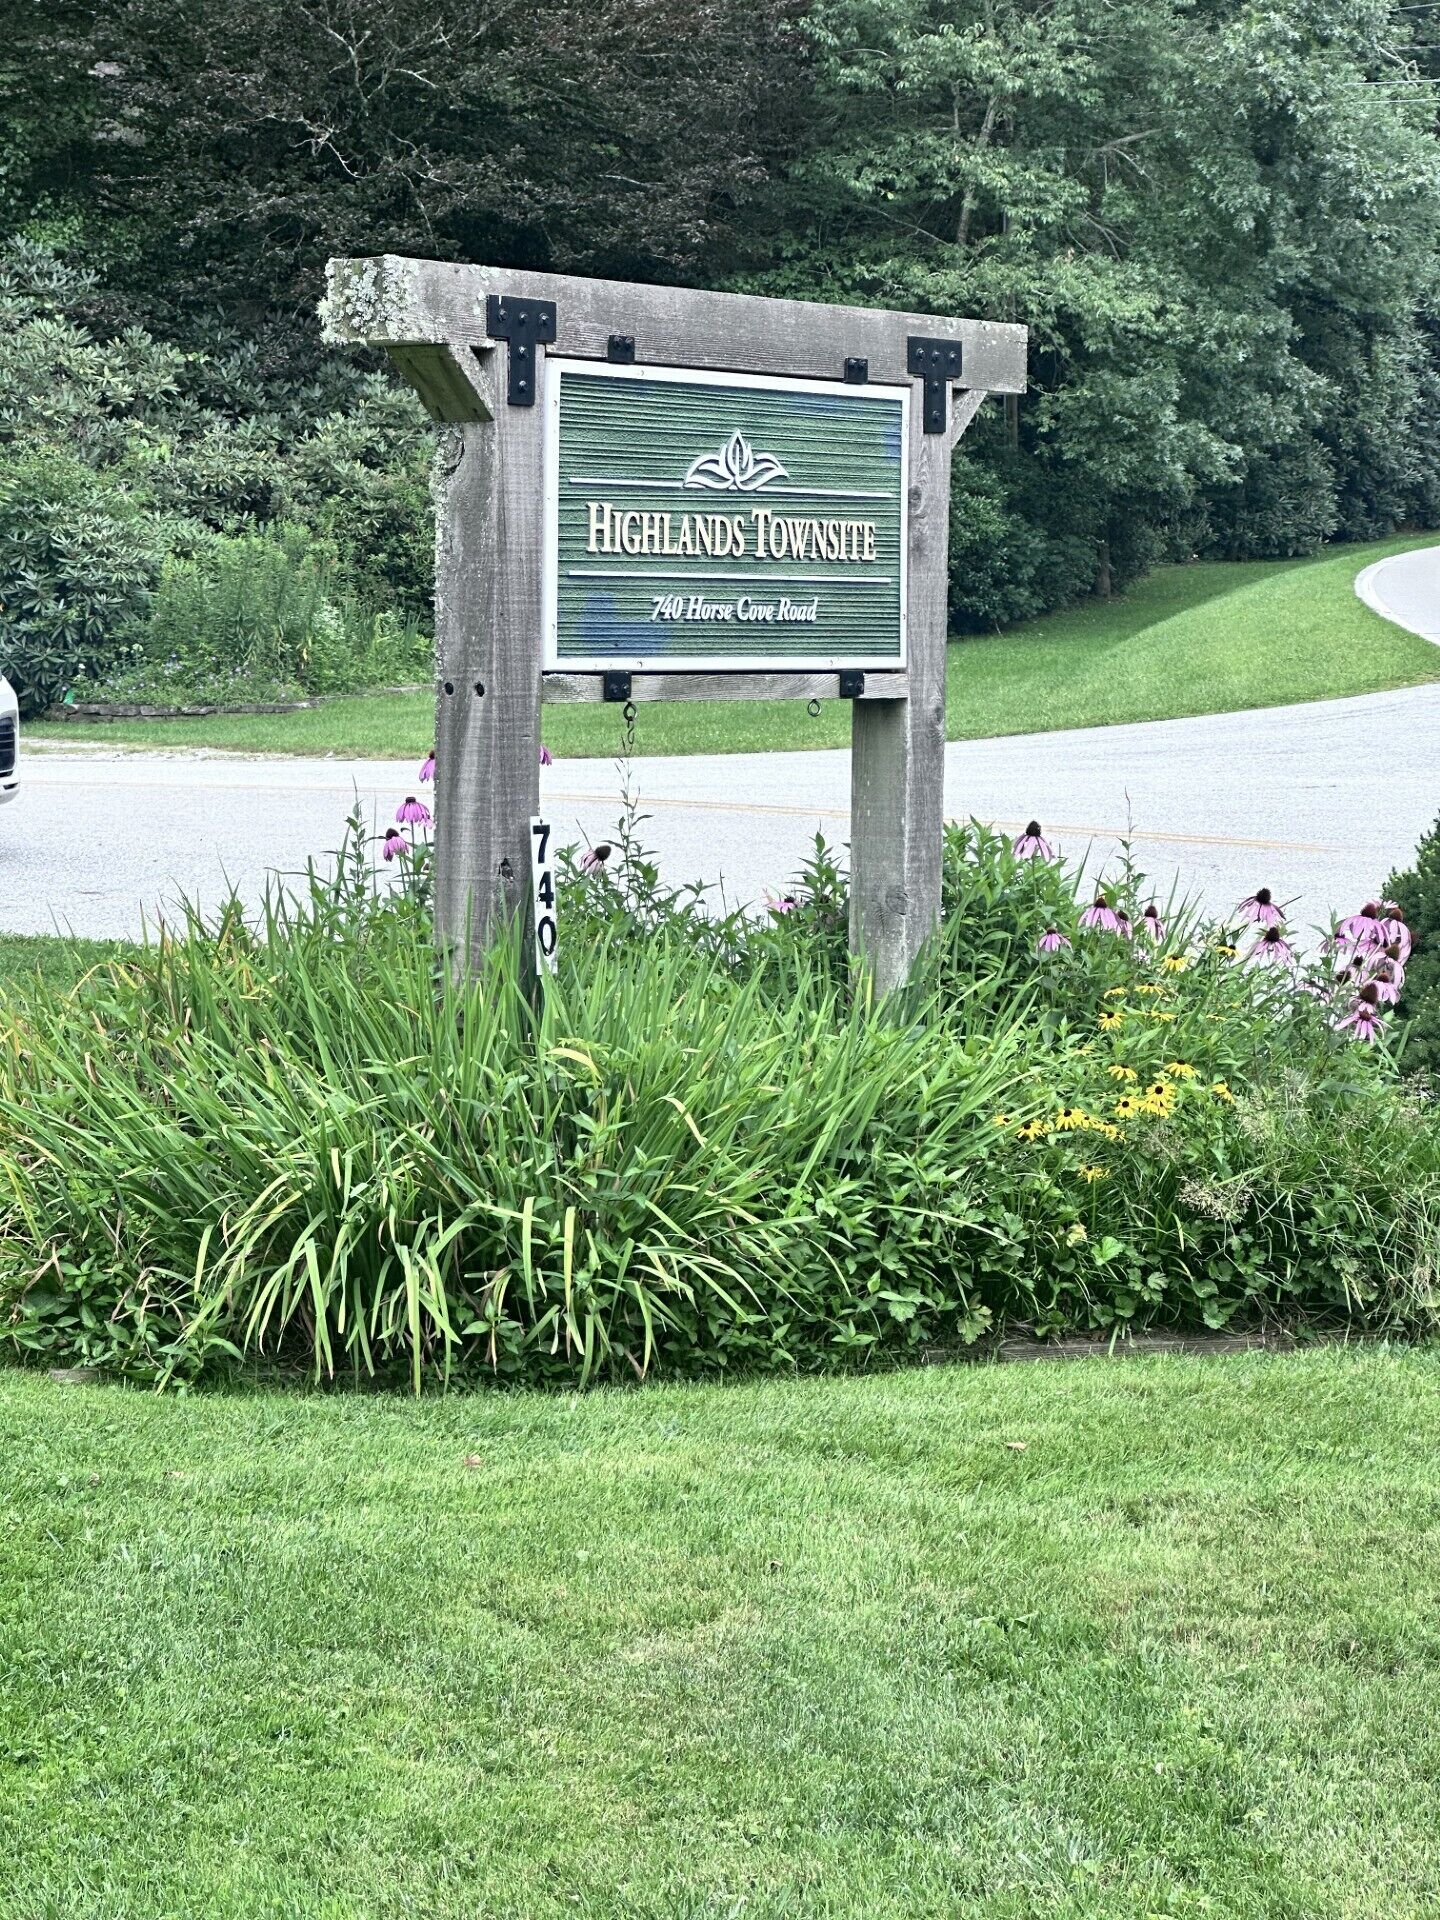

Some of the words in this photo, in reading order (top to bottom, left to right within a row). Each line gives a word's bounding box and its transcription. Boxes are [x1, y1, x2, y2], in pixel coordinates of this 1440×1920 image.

[586, 502, 745, 558] HIGHLANDS
[751, 508, 876, 561] TOWNSITE
[651, 595, 683, 621] 740
[686, 596, 732, 620] Horse
[736, 597, 774, 621] Cove
[776, 597, 819, 622] Road
[532, 824, 557, 956] 740
